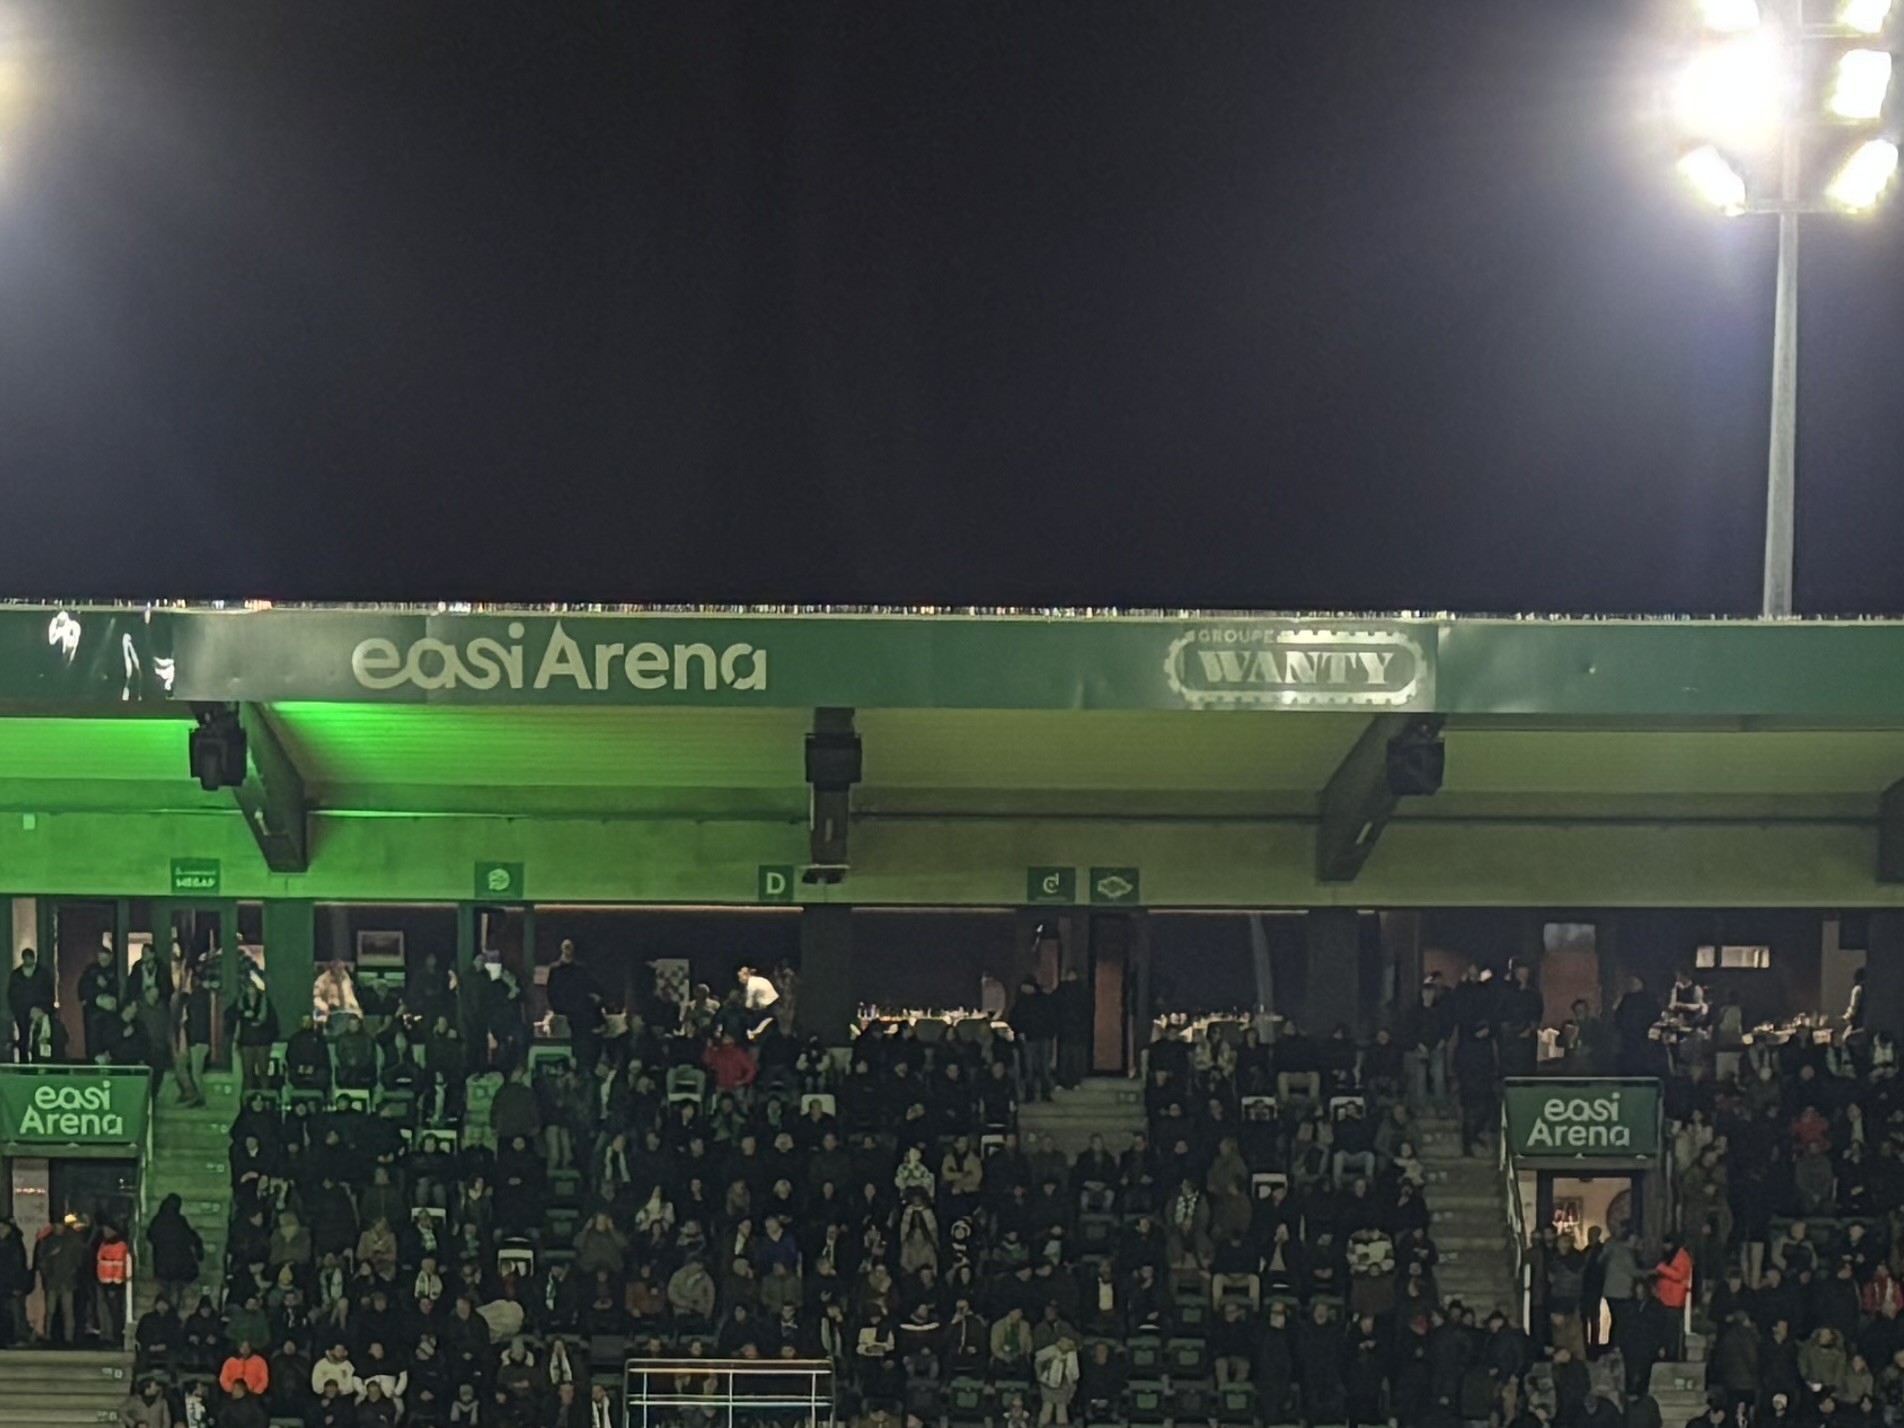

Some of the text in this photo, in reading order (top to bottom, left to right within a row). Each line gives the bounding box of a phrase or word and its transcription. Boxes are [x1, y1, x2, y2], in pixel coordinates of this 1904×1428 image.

[1198, 630, 1275, 643] GROUPE
[1198, 650, 1395, 684] WANTY
[766, 872, 785, 895] D
[34, 1080, 111, 1110] easi
[1543, 1092, 1621, 1121] easi
[19, 1104, 123, 1135] Arena
[1526, 1117, 1630, 1146] Arena
